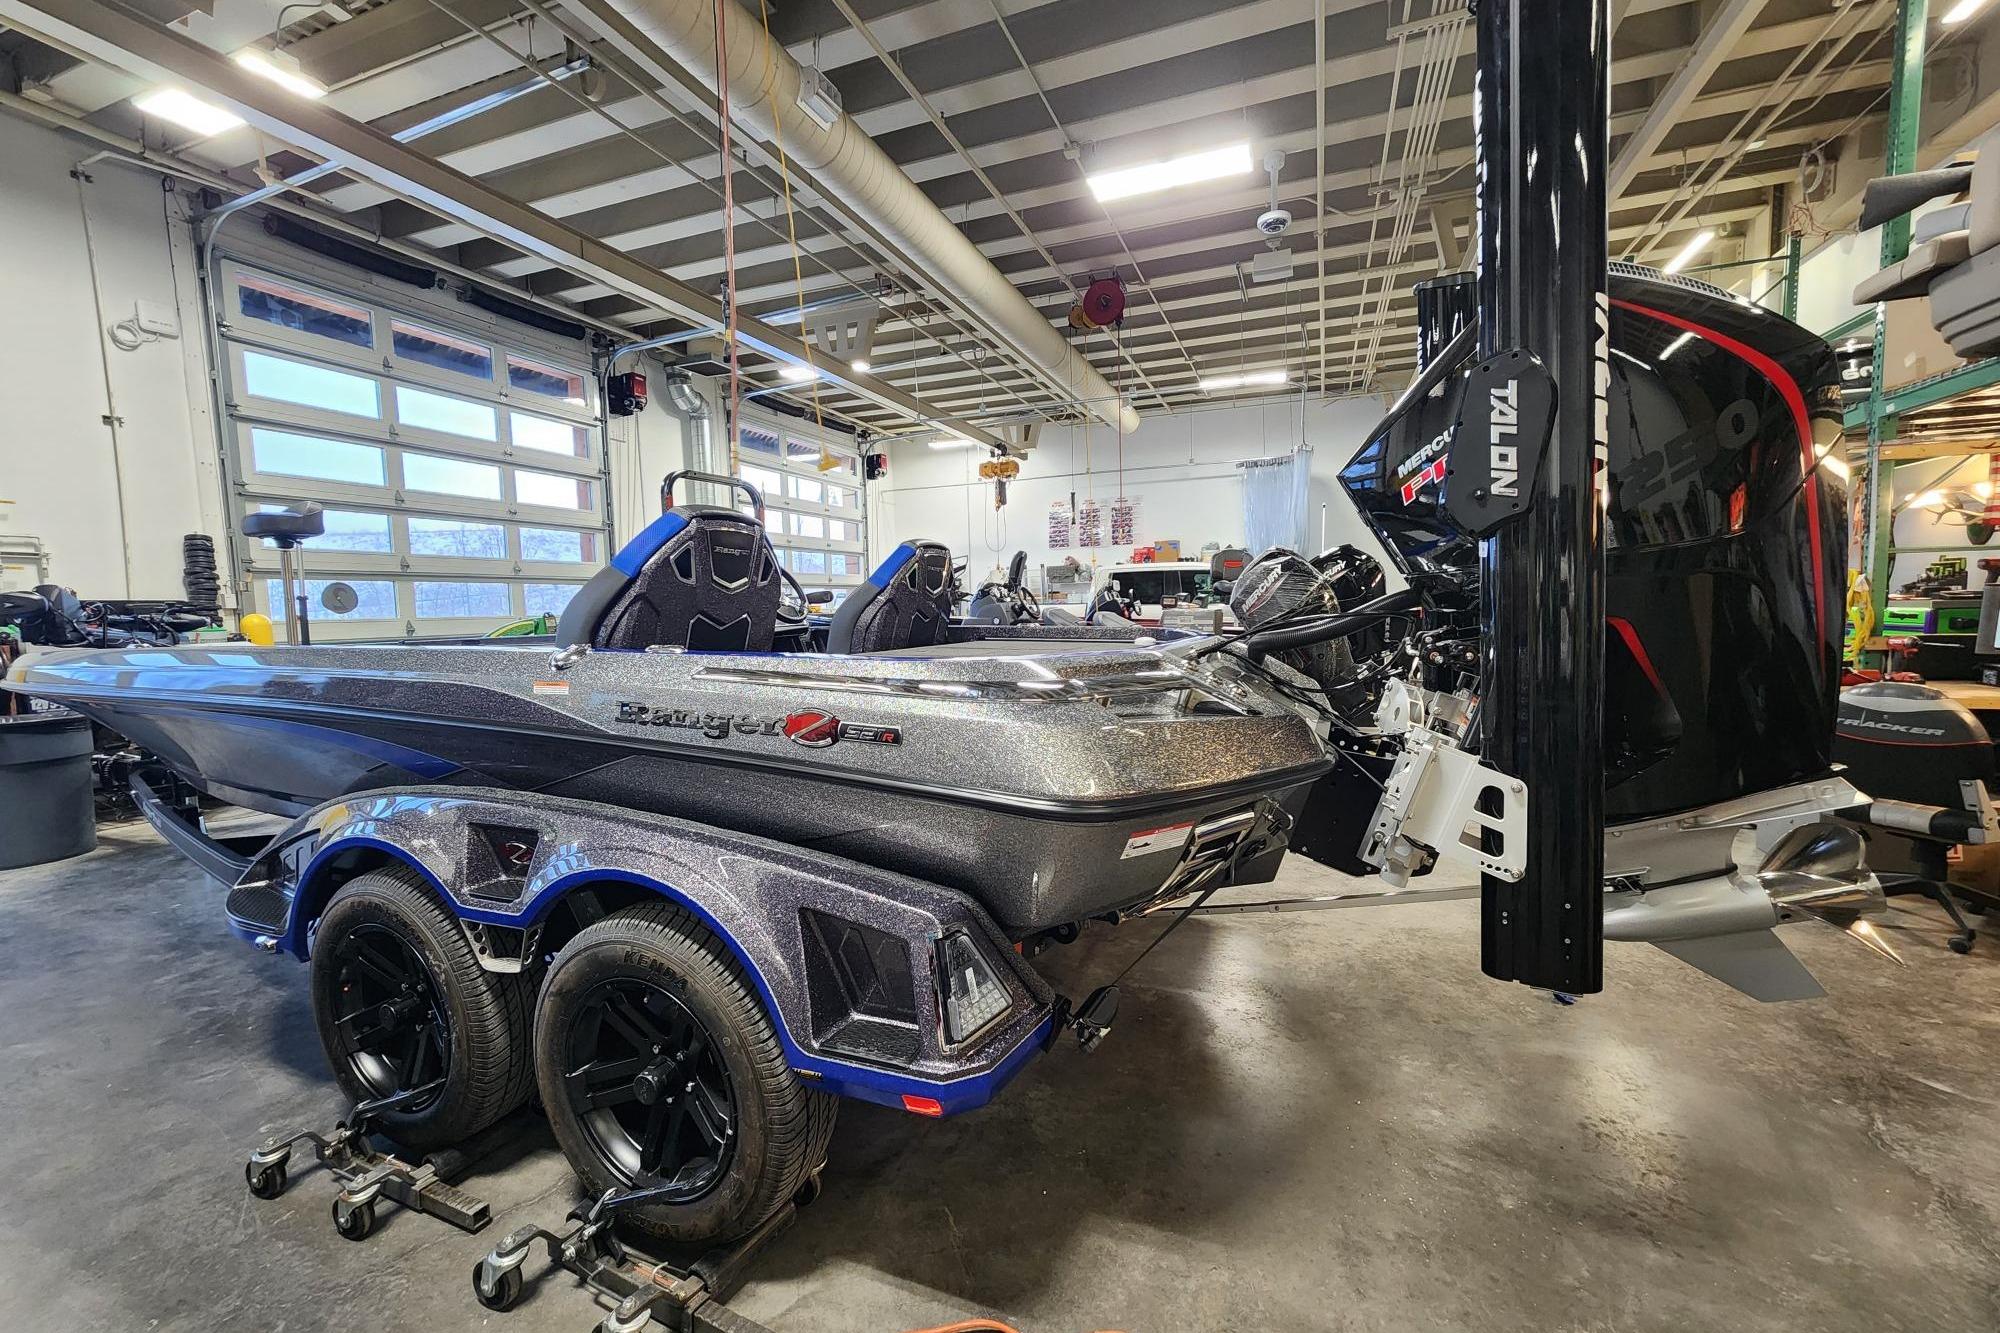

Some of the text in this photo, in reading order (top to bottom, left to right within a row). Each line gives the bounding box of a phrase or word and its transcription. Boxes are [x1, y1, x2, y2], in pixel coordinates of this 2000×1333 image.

[1397, 425, 1455, 480] MERCU
[1490, 379, 1518, 497] TALON
[1618, 399, 1760, 513] 250
[1323, 560, 1347, 578] CURY
[614, 701, 787, 740] Ranger
[1836, 717, 1946, 736] TRACKER
[623, 949, 690, 993] KENDA
